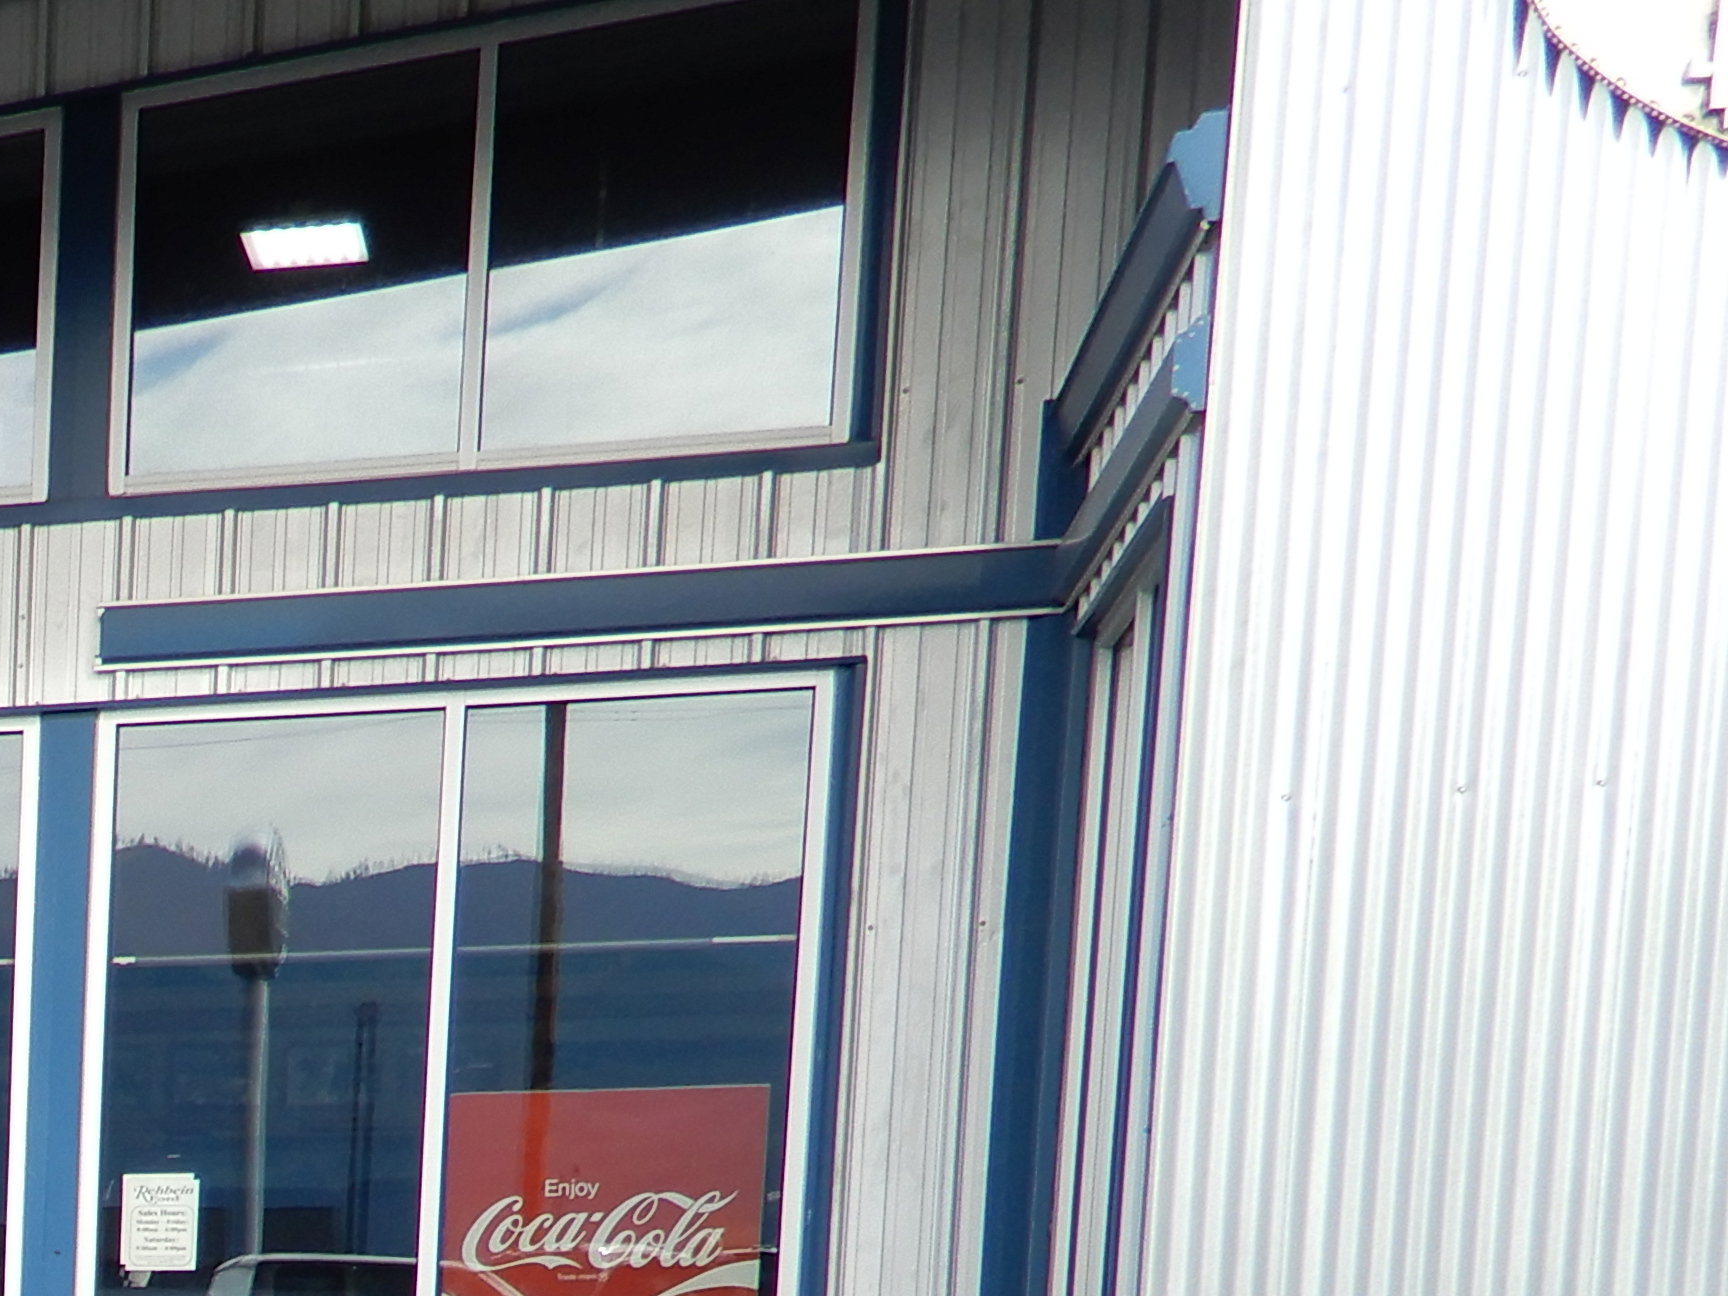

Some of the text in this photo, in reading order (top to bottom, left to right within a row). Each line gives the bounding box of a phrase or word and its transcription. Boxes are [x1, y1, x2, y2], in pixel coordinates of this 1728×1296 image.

[134, 1185, 194, 1204] Rehbein
[543, 1178, 600, 1200] Enjoy
[138, 1208, 158, 1217] Sales
[461, 1189, 740, 1270] Coca-Cola
